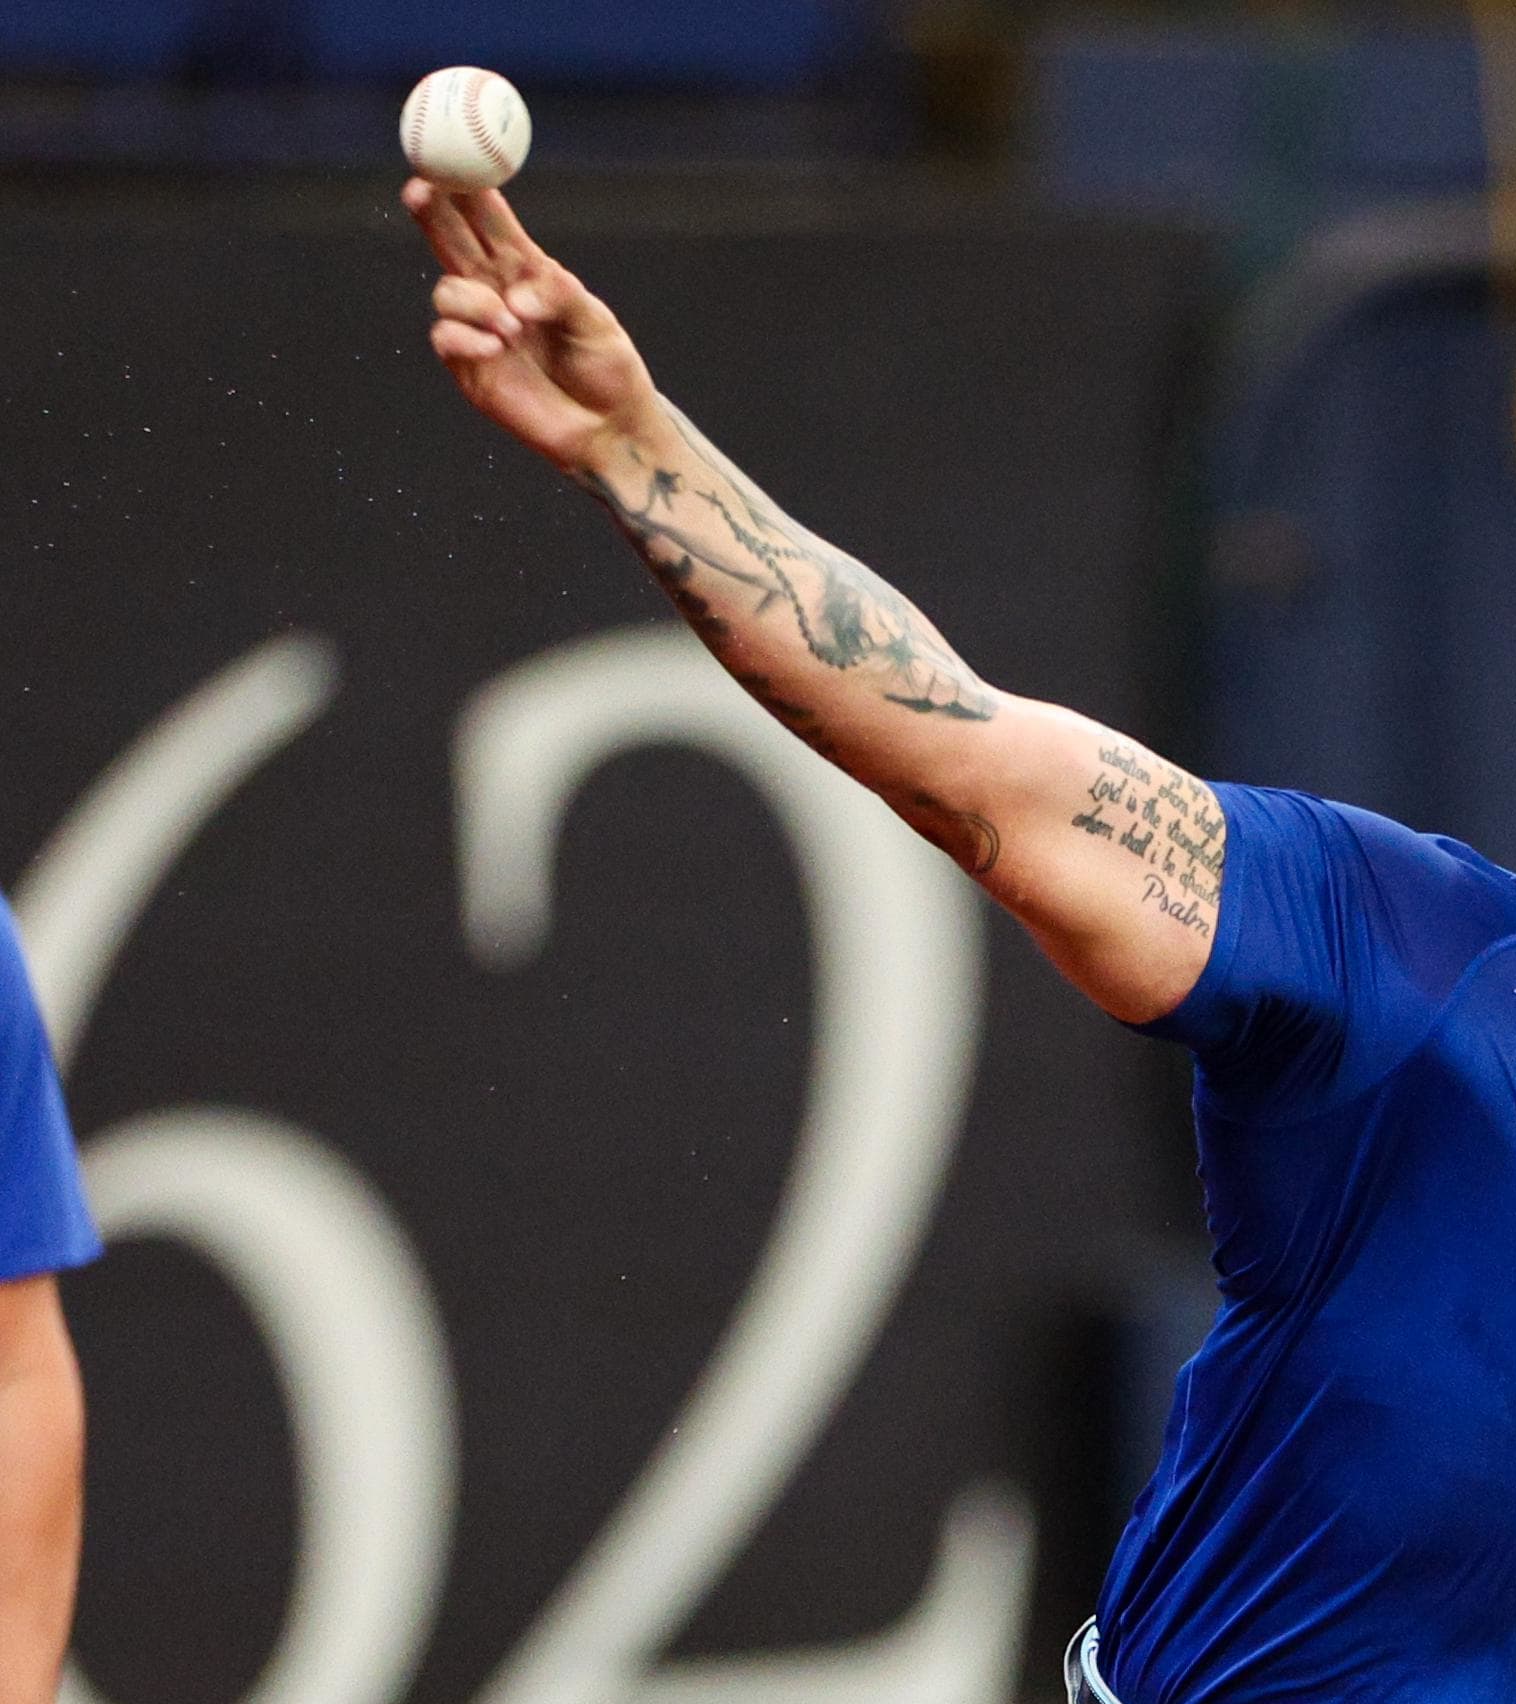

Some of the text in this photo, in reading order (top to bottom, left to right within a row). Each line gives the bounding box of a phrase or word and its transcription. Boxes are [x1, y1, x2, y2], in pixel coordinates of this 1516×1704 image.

[1126, 787, 1137, 813] is
[1142, 798, 1161, 829] the
[1071, 805, 1114, 840] whom
[1119, 822, 1153, 858] shall
[1162, 847, 1175, 877] be
[1142, 874, 1209, 938] Psalm
